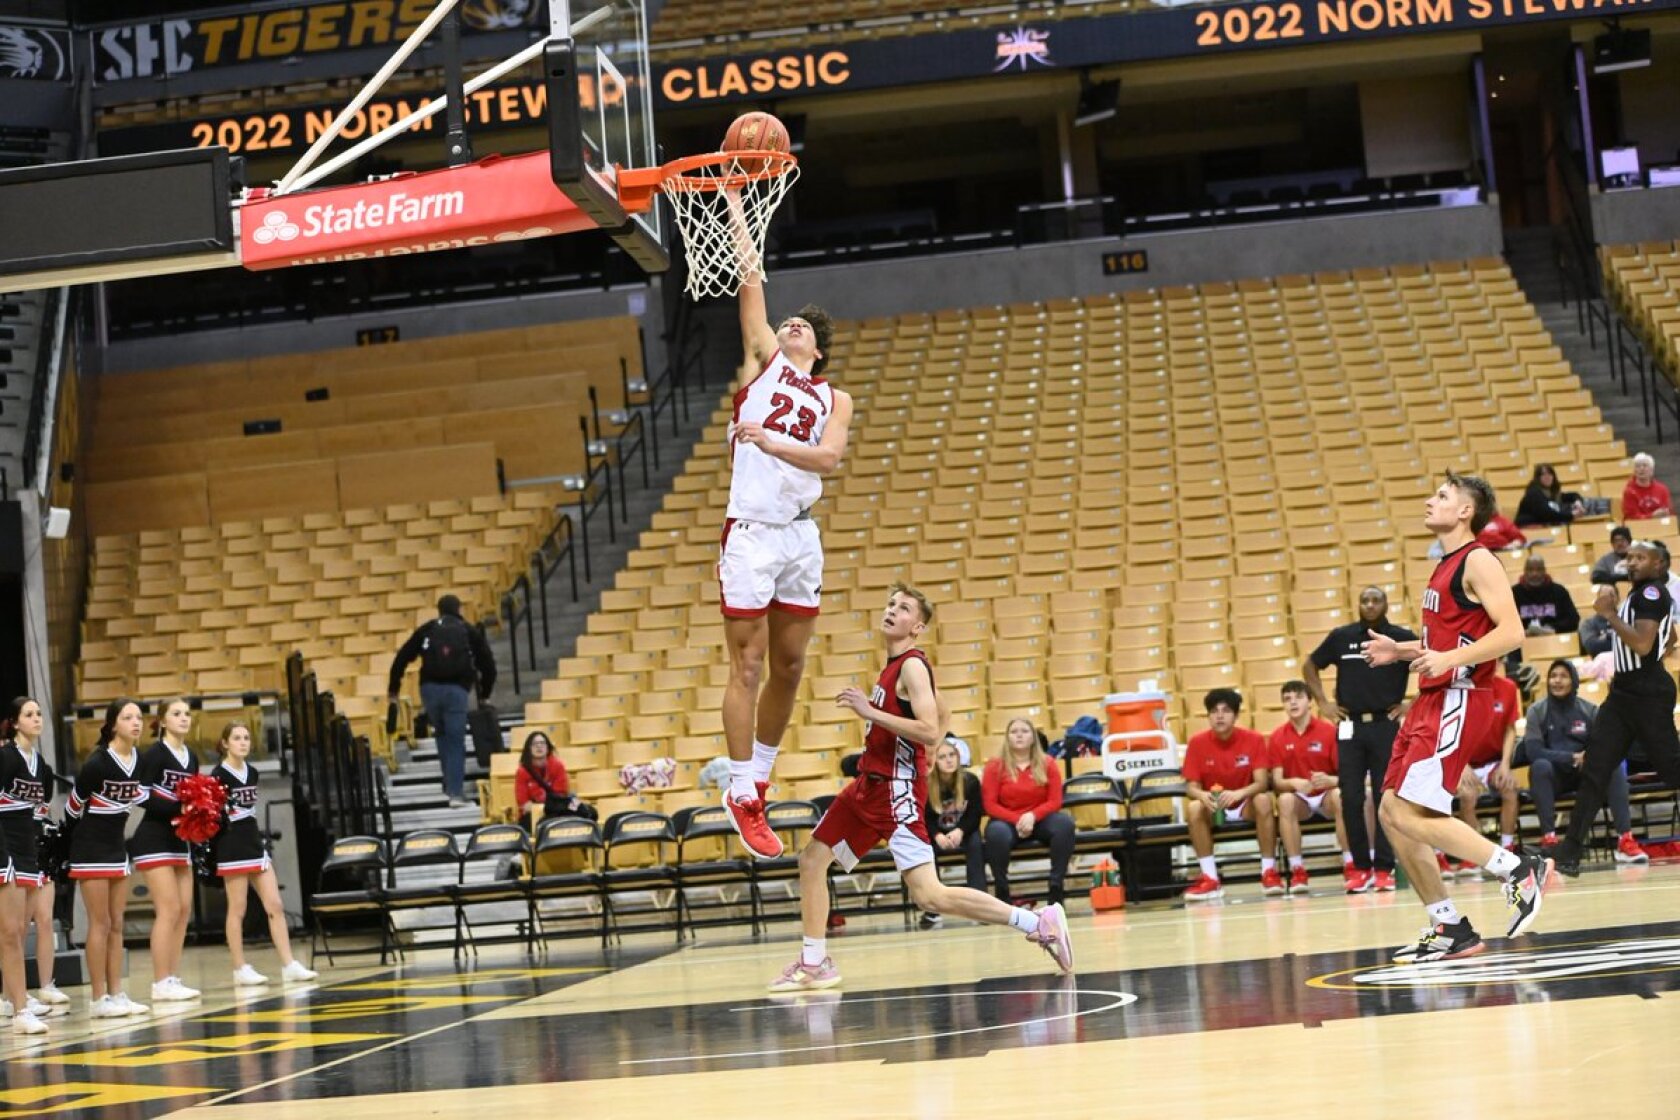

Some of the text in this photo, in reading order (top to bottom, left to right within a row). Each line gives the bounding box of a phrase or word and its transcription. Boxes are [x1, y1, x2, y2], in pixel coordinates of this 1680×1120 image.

[199, 0, 438, 64] TIGERS
[1195, 3, 1304, 45] 2022
[1317, 0, 1454, 34] NORM
[191, 114, 292, 153] 2022
[304, 98, 434, 144] NORM
[661, 51, 850, 101] CLASSIC
[762, 391, 817, 442] 23
